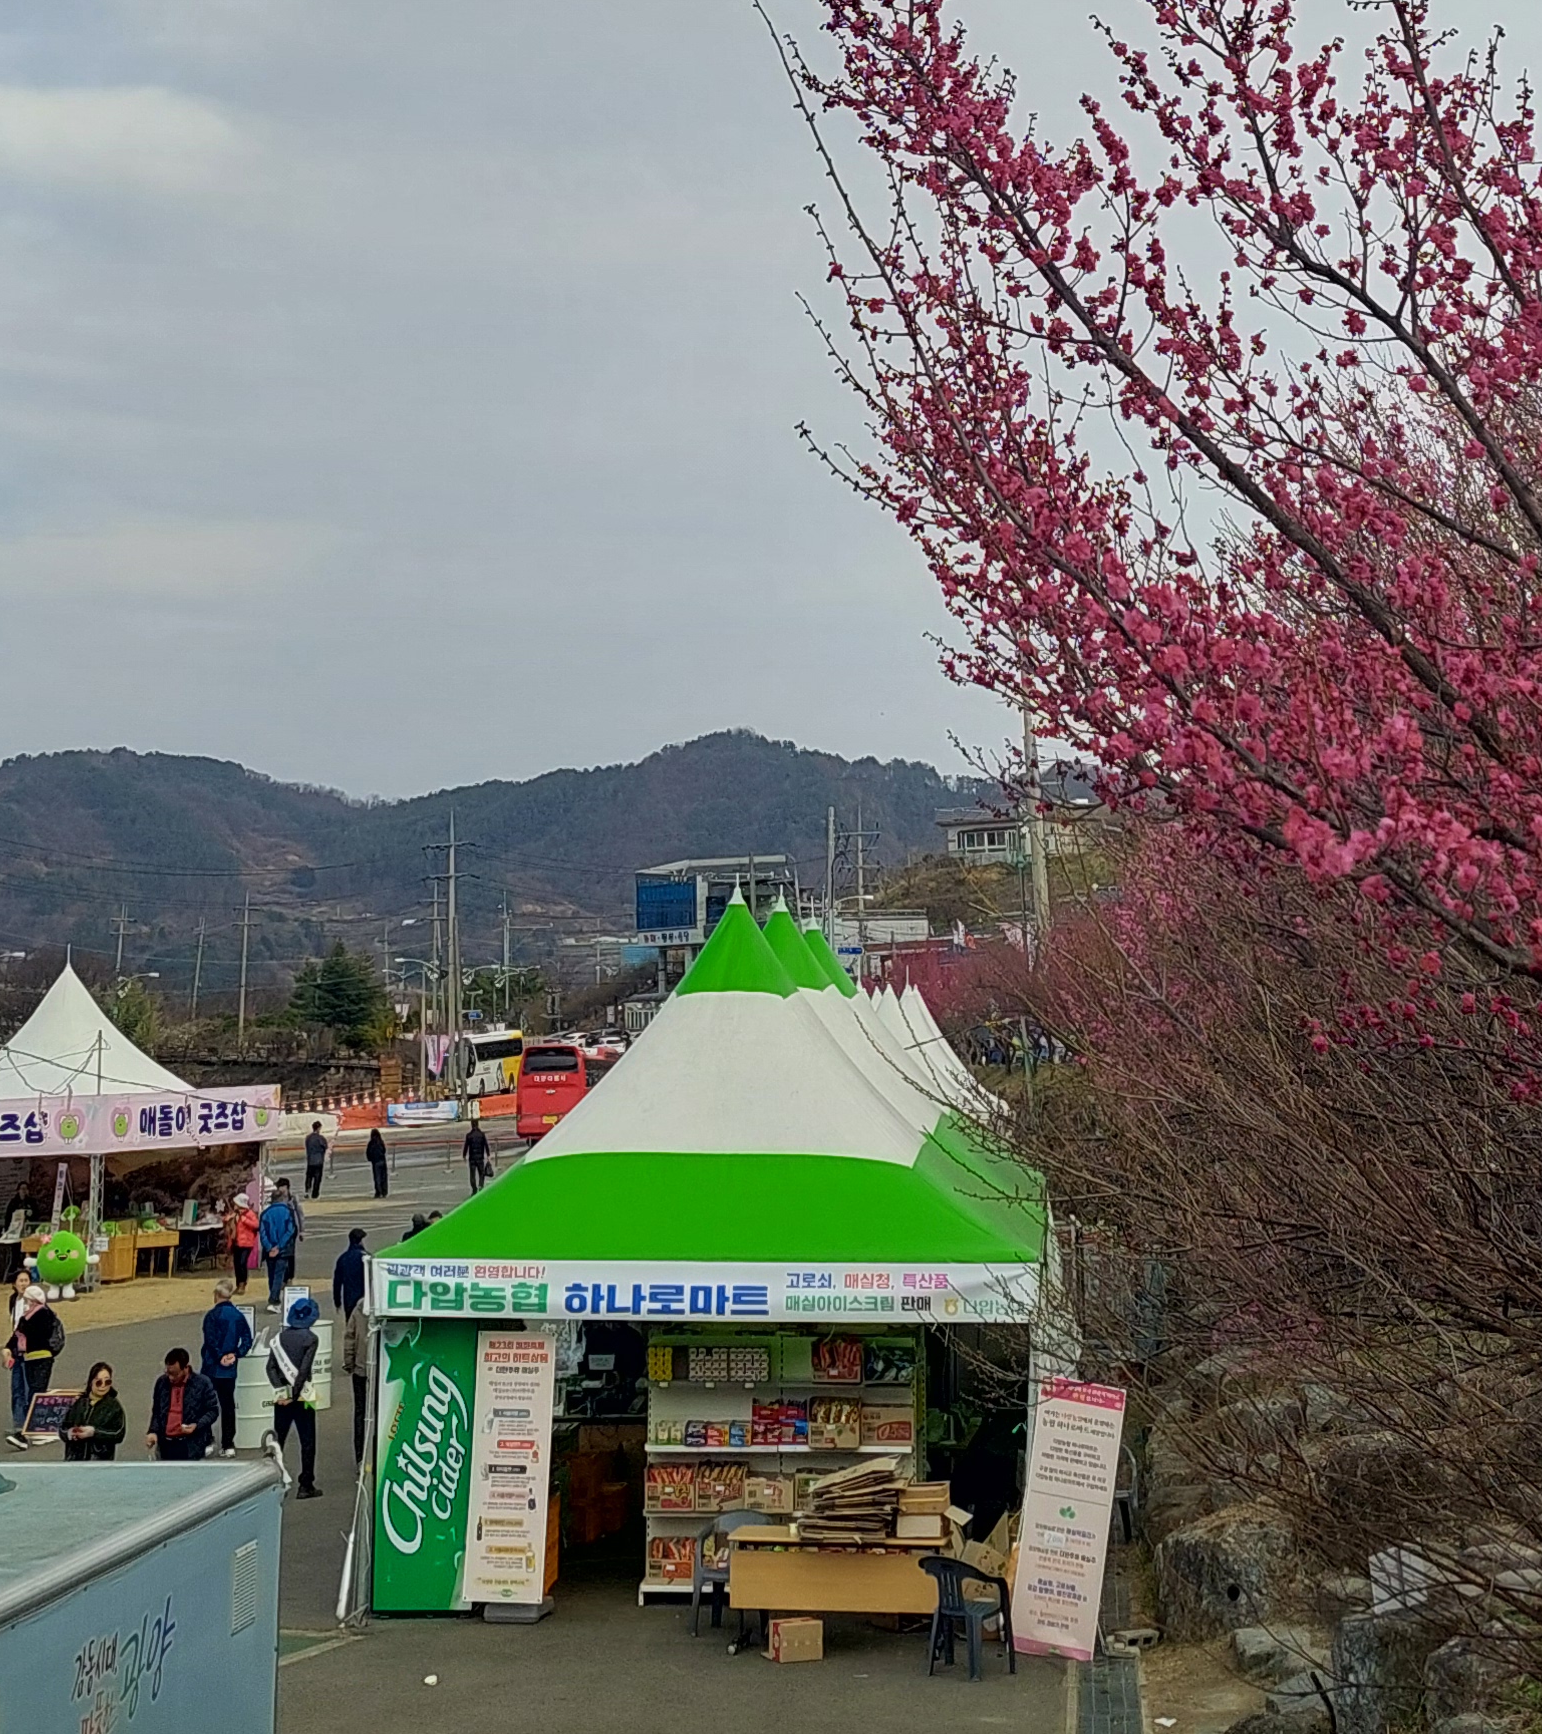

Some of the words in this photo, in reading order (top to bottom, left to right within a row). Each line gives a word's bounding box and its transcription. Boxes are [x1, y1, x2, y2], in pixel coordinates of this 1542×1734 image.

[139, 1104, 191, 1137] 매돌이
[198, 1099, 247, 1134] 굿즈샵
[430, 1264, 469, 1279] 여러분
[474, 1265, 546, 1280] 환영합니다!
[785, 1272, 836, 1290] 고로쇠,
[844, 1272, 895, 1291] 매실청,
[902, 1272, 949, 1290] 특산품
[387, 1279, 549, 1314] 다압농협
[564, 1282, 770, 1316] 하나로마트
[785, 1295, 895, 1314] 매실아이스크림
[901, 1296, 932, 1313] 판매
[484, 1352, 510, 1363] 최고의
[512, 1353, 548, 1363] 히트상품
[382, 1365, 468, 1555] Chilsung
[431, 1412, 467, 1520] Cider
